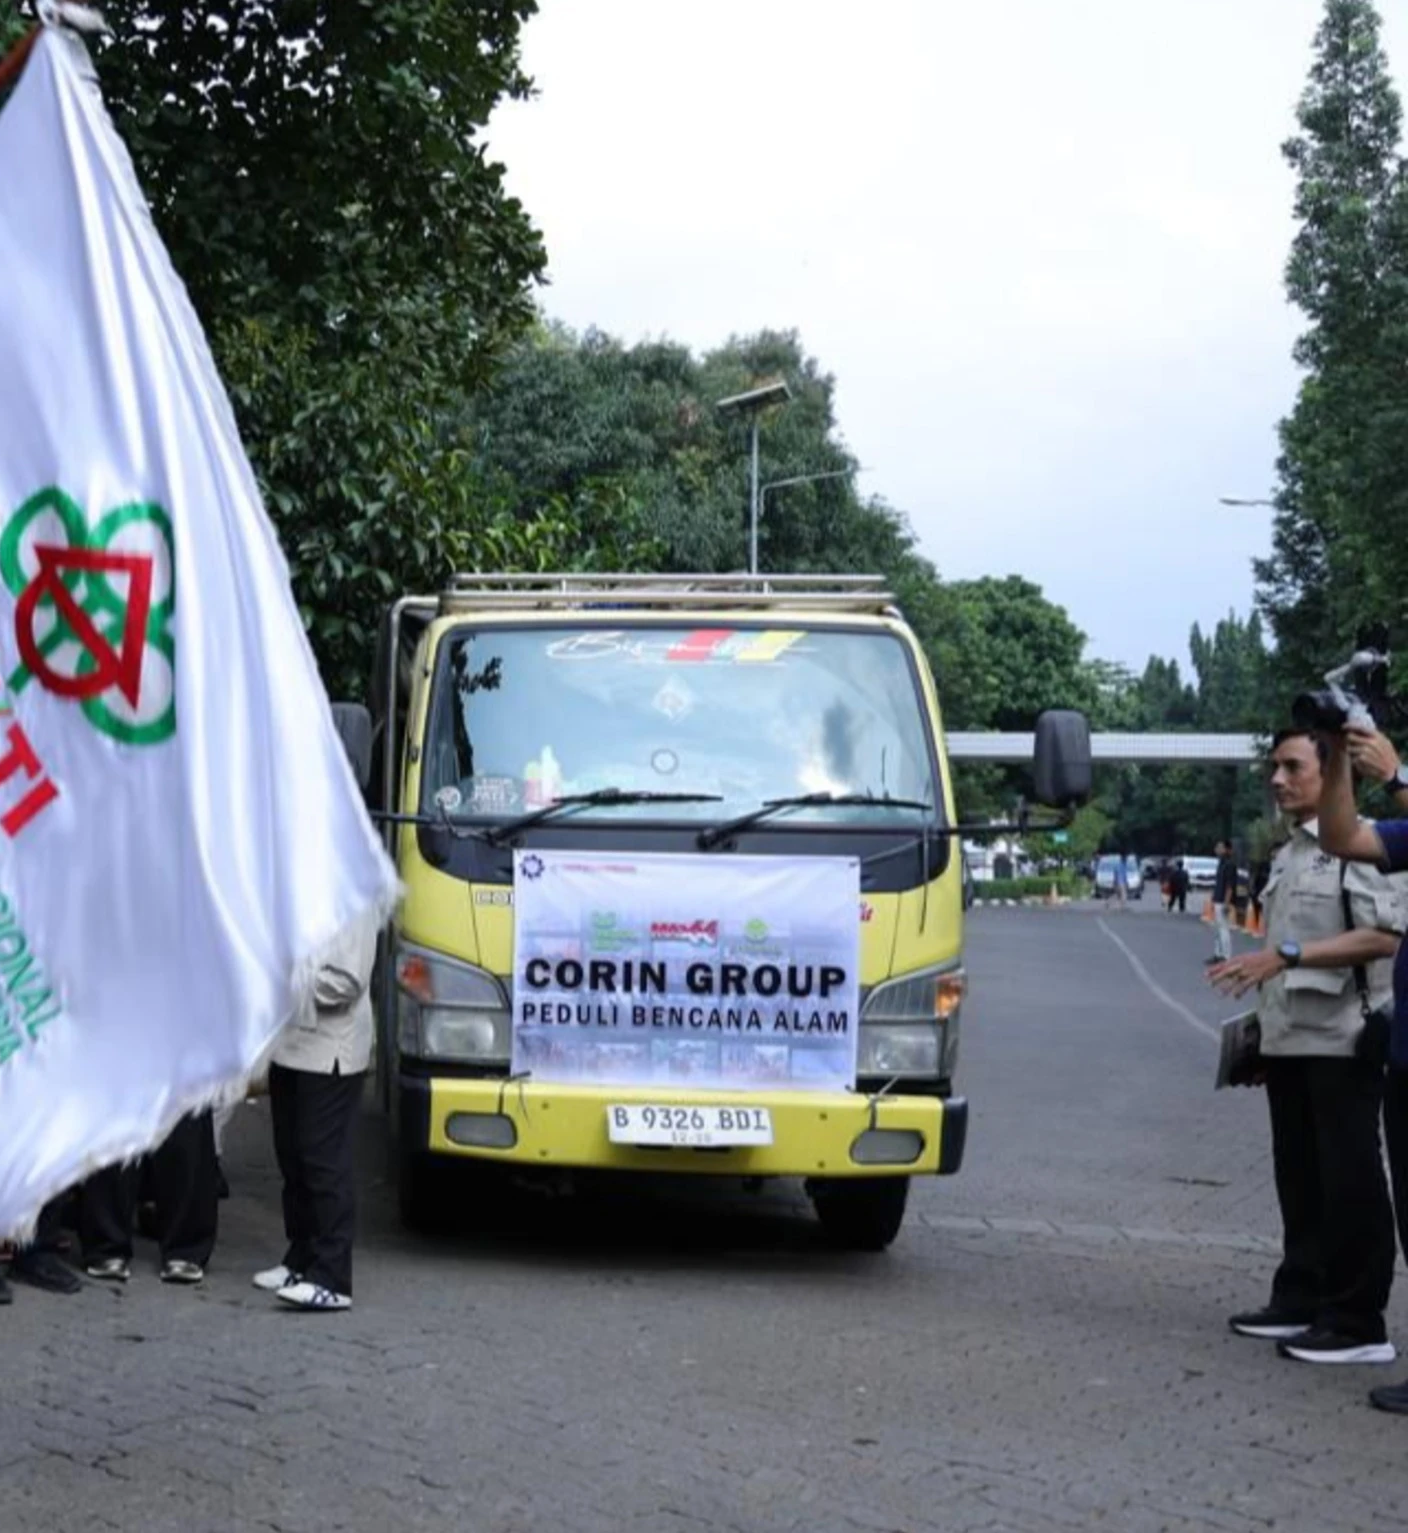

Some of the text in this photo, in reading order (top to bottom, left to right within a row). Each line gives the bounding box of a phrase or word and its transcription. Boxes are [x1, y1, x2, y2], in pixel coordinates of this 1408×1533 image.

[525, 958, 847, 998] CORIN GROUP
[522, 1001, 849, 1033] PEDULI BENCANA ALAM
[613, 1106, 768, 1131] B 9326 BDI
